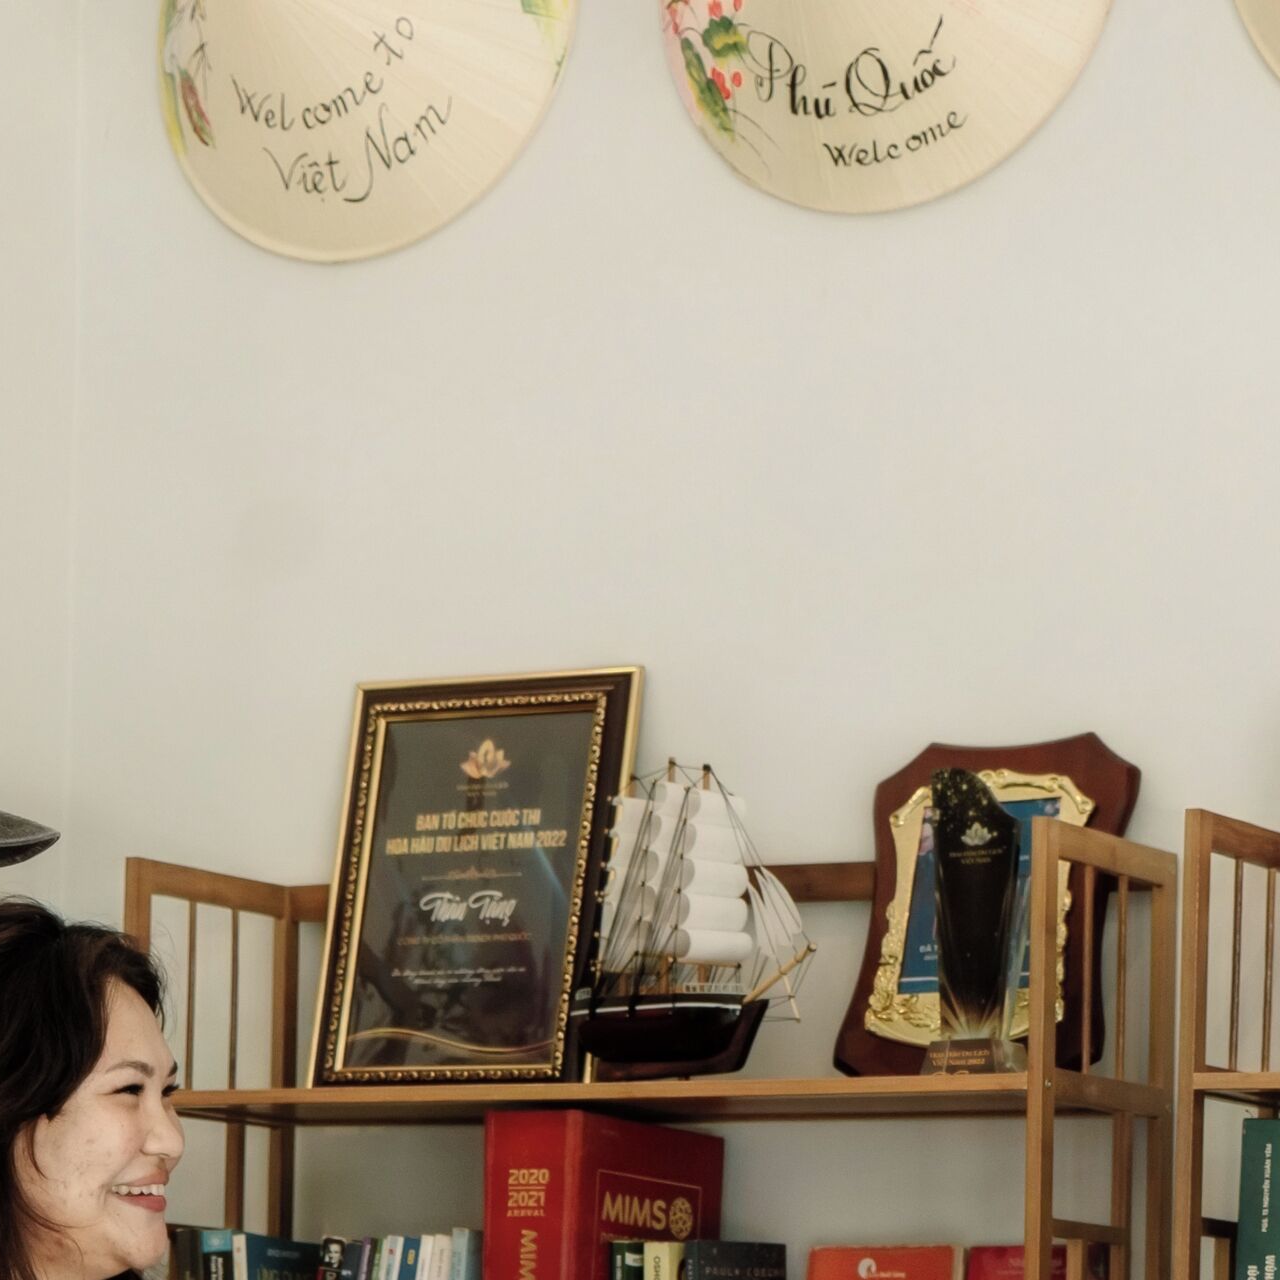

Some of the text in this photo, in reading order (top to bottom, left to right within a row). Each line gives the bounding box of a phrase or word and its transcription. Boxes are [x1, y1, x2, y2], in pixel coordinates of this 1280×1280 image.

[231, 16, 414, 131] Welcome to
[263, 96, 453, 203] Việt Nam
[822, 109, 968, 168] Welcome
[507, 831, 535, 849] NAM
[536, 830, 567, 848] 2022
[508, 1168, 549, 1186] 2020
[507, 1190, 545, 1208] 2021
[601, 1190, 666, 1231] MIMS
